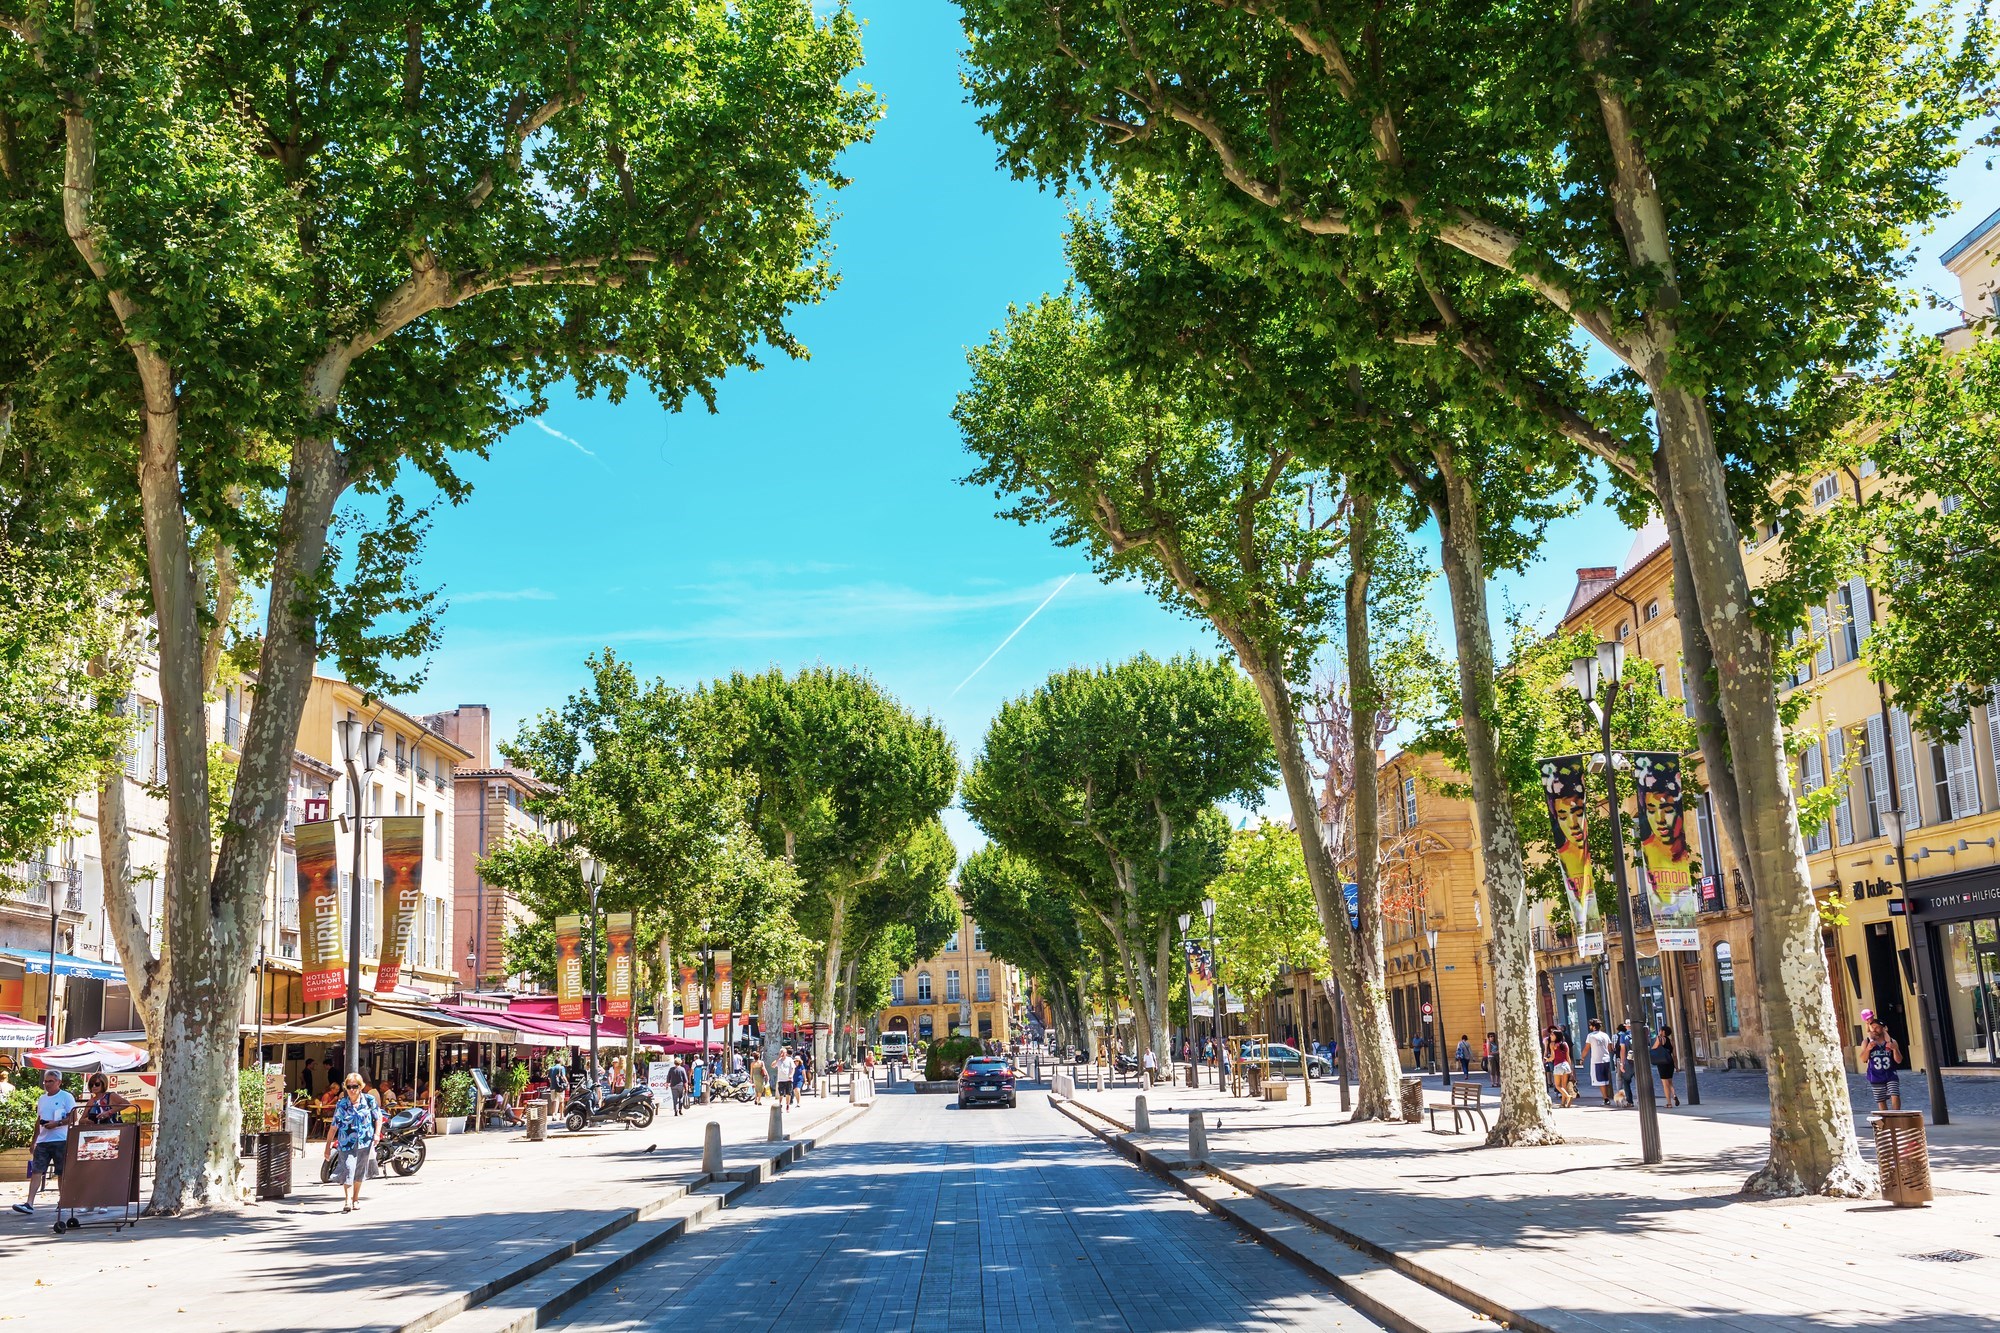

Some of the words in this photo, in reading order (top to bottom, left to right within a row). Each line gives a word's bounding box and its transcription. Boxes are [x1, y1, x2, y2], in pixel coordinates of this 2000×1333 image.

[308, 803, 326, 820] H
[1930, 894, 1961, 908] TOMMY
[315, 893, 340, 964] TURNER
[395, 889, 418, 957] TURNER
[306, 977, 341, 987] CAUMONT
[566, 957, 581, 1000] TURNER
[616, 955, 630, 996] TURNER
[687, 982, 699, 1013] TURNER
[721, 980, 731, 1010] TURNER
[1874, 1056, 1891, 1070] 33
